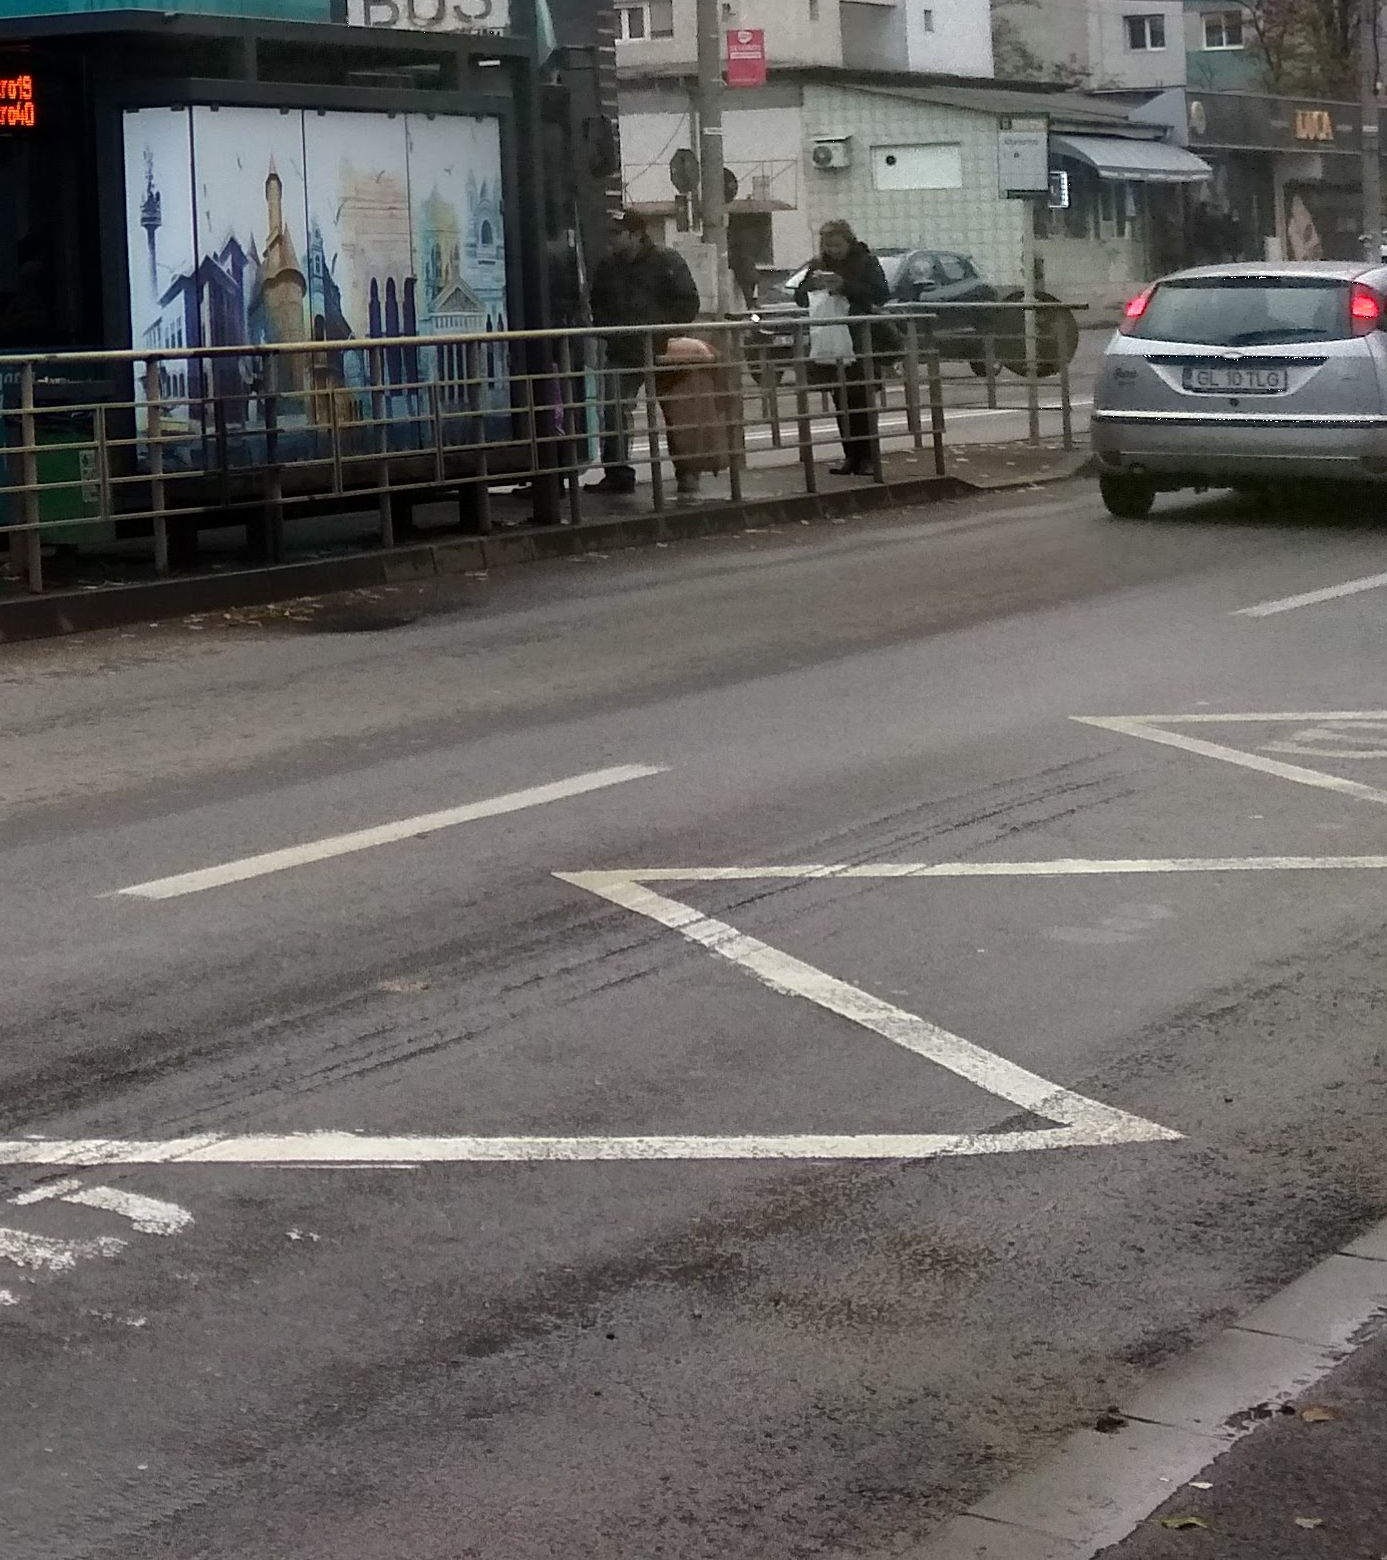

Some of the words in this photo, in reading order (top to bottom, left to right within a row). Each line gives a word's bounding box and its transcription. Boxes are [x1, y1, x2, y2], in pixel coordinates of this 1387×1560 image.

[1197, 370, 1219, 387] GL
[1228, 370, 1242, 386] 10
[1246, 371, 1279, 388] TLG
